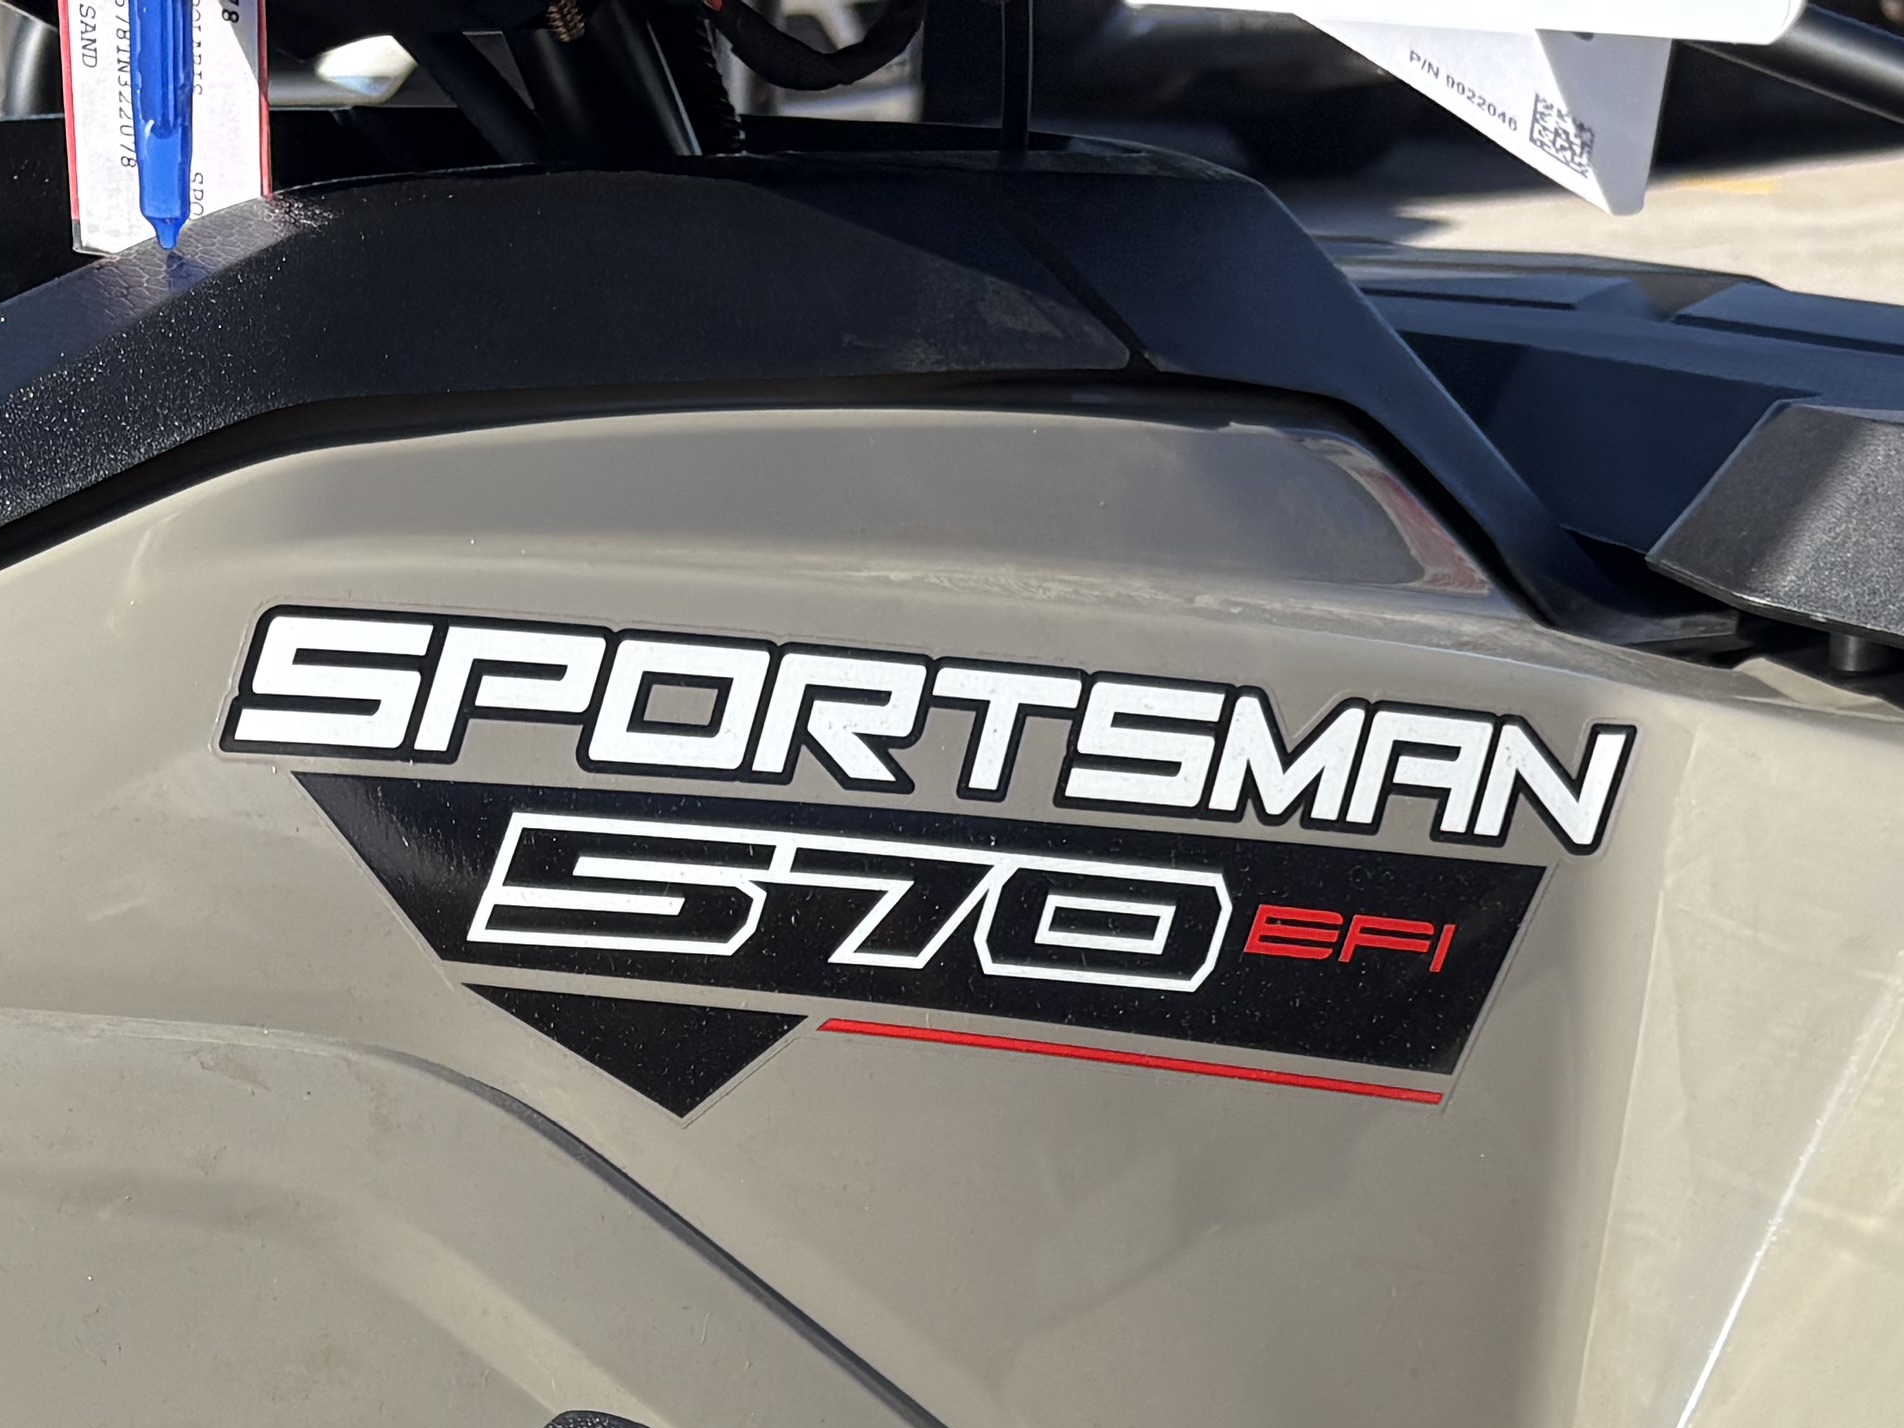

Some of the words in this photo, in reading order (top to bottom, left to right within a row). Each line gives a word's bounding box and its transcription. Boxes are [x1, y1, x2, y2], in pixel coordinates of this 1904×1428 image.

[78, 3, 98, 69] SAND
[1407, 49, 1441, 80] P/N
[228, 612, 1628, 850] SPORTSMAN
[466, 808, 1233, 992] 570
[1242, 903, 1460, 973] EFI
